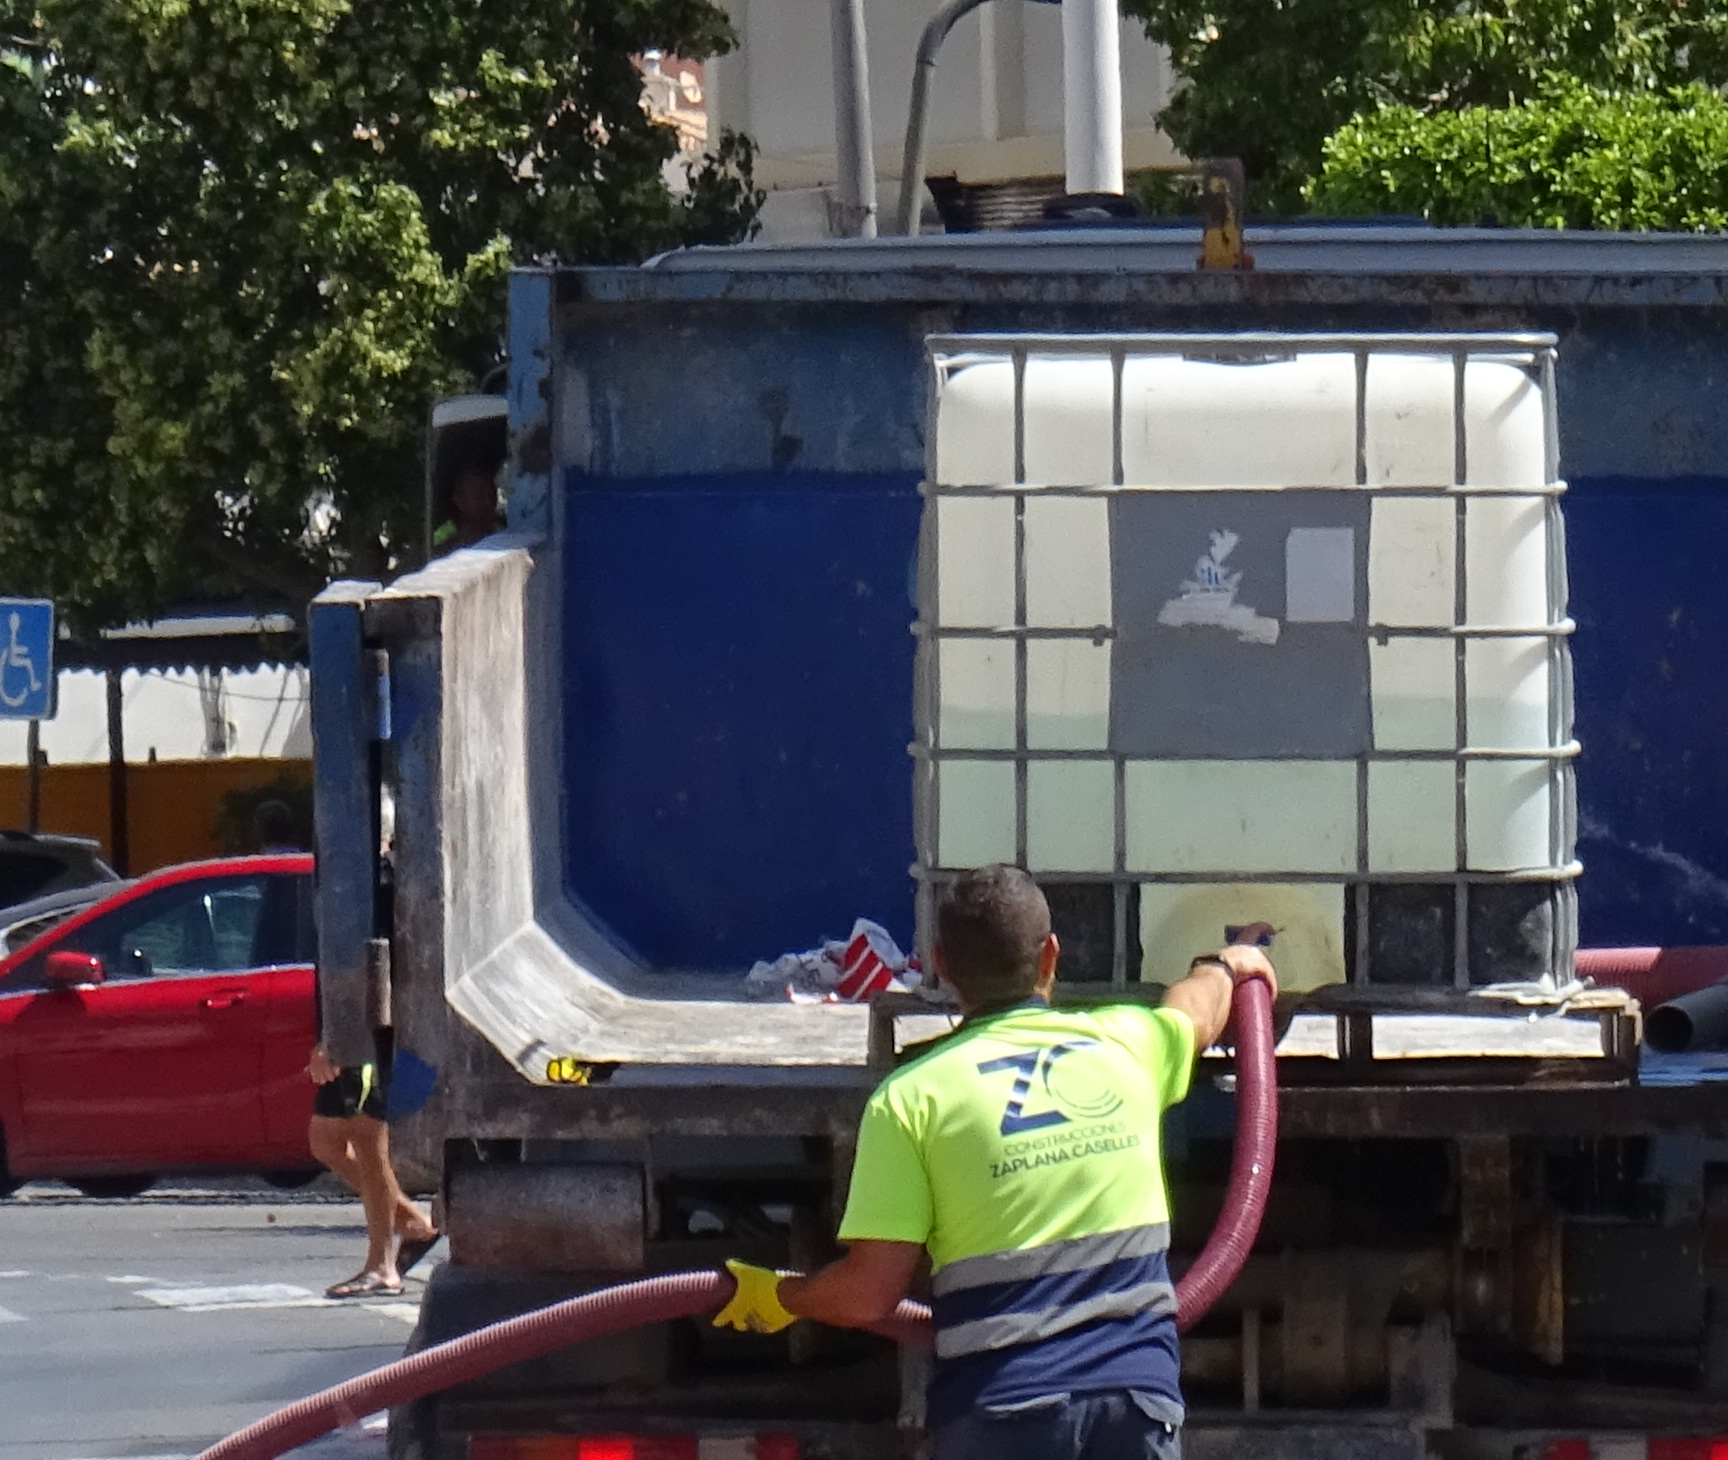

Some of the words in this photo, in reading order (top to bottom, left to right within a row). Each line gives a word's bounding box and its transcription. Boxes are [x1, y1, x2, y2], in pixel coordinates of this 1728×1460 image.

[990, 1147, 1072, 1179] ZAPLANA
[1072, 1134, 1141, 1159] CASELLES
[1004, 1120, 1127, 1156] CONSTRUCCIONES
